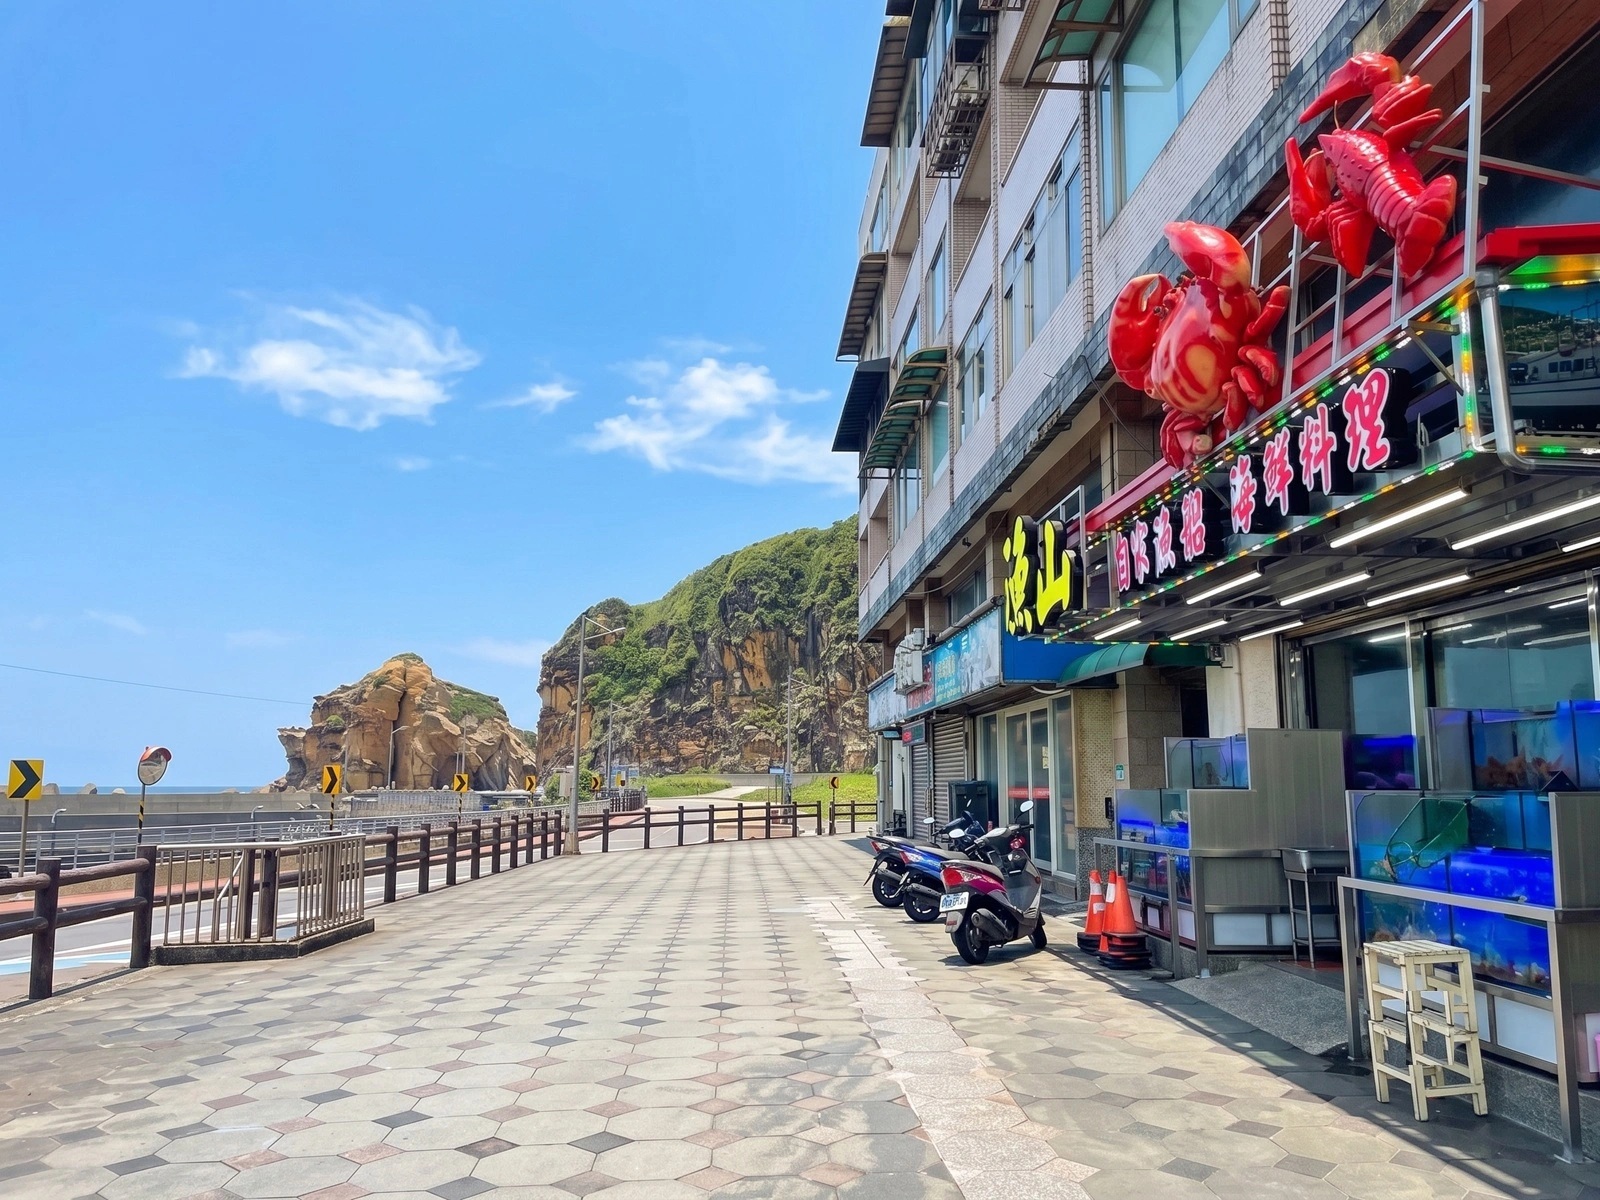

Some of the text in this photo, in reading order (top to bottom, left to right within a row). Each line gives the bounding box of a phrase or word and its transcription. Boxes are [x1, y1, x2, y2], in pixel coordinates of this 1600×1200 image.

[1229, 368, 1391, 534] 海鮮料理
[1003, 515, 1071, 636] 漁山
